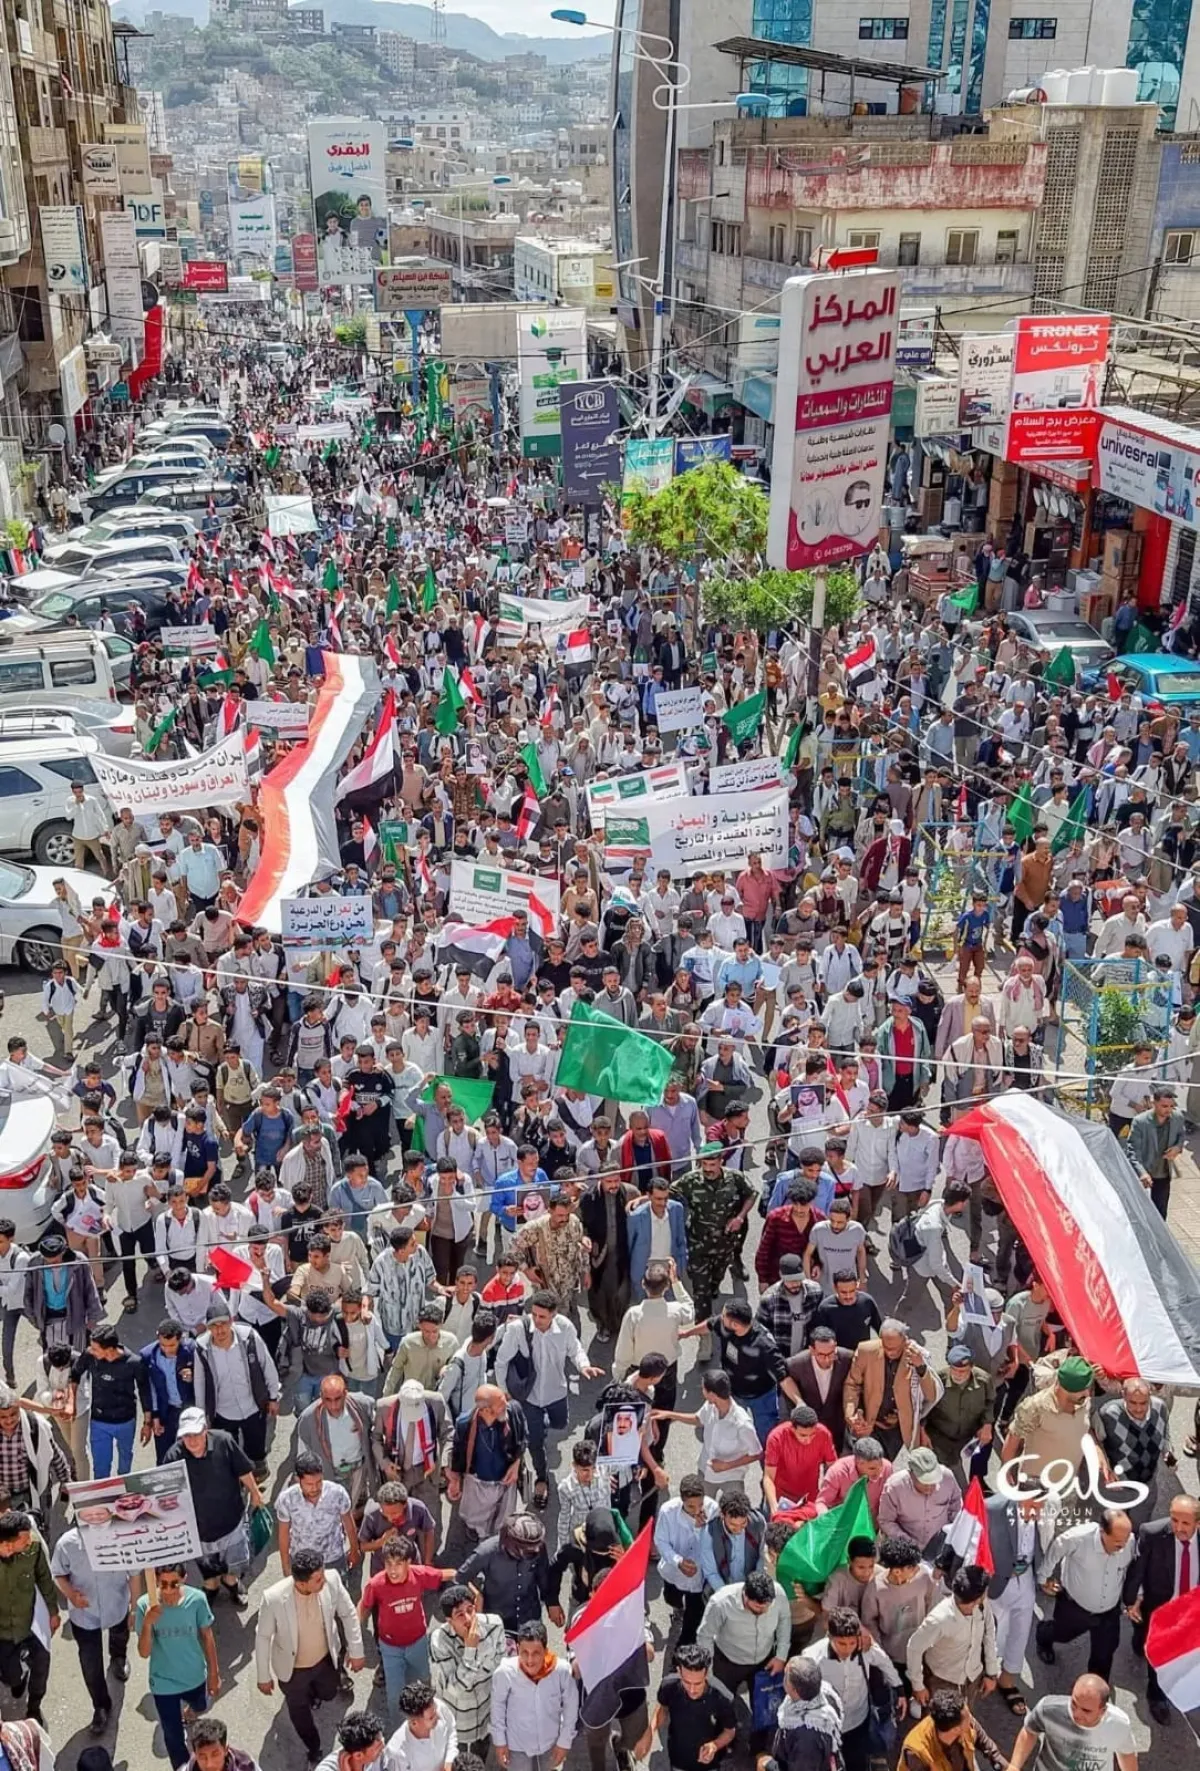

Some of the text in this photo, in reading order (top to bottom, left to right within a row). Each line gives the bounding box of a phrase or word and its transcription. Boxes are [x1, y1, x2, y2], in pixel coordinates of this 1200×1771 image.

[808, 286, 896, 332] المركز
[1030, 324, 1100, 338] TRONEX
[1030, 339, 1099, 356] ترونكس
[805, 331, 892, 385] العربي
[579, 393, 602, 409] YCB
[801, 388, 887, 422] للنظارات والسمعيات
[1014, 415, 1097, 429] معرض برج السلام
[1100, 435, 1159, 469] univesral
[177, 758, 215, 777] دمرت
[167, 779, 207, 798] وسوريا
[207, 772, 238, 790] العراق
[133, 785, 168, 804] ولبنان
[721, 805, 781, 825] السعودية
[674, 825, 782, 850] وحدة العقيدة والتاريخ
[289, 903, 323, 917] الدرعية
[353, 902, 365, 916] من
[289, 917, 366, 932] نحن درع الجزيرة
[112, 1520, 187, 1541] من تعز
